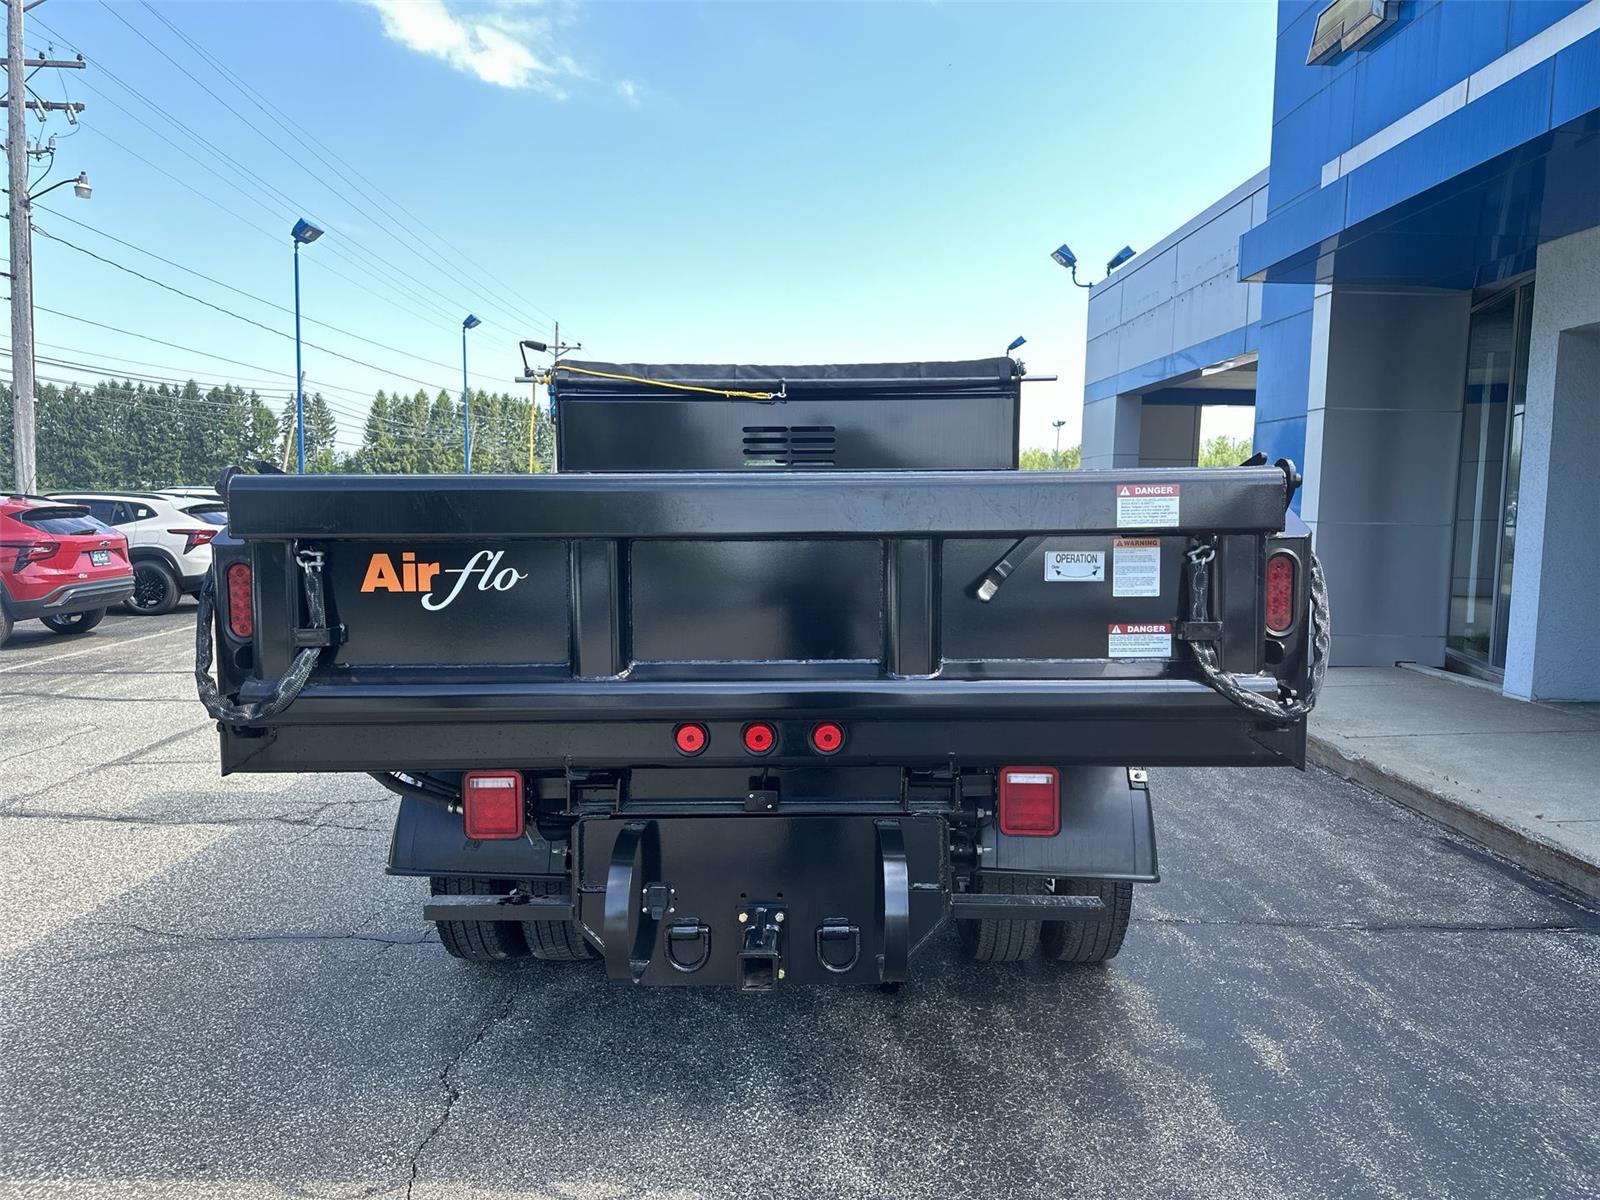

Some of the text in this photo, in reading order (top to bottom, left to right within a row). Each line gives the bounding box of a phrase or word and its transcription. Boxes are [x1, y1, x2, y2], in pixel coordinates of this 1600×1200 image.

[1135, 486, 1174, 495] DANGER
[1055, 553, 1098, 564] OPERATION
[360, 551, 440, 593] Air
[1127, 625, 1166, 633] DANGER
